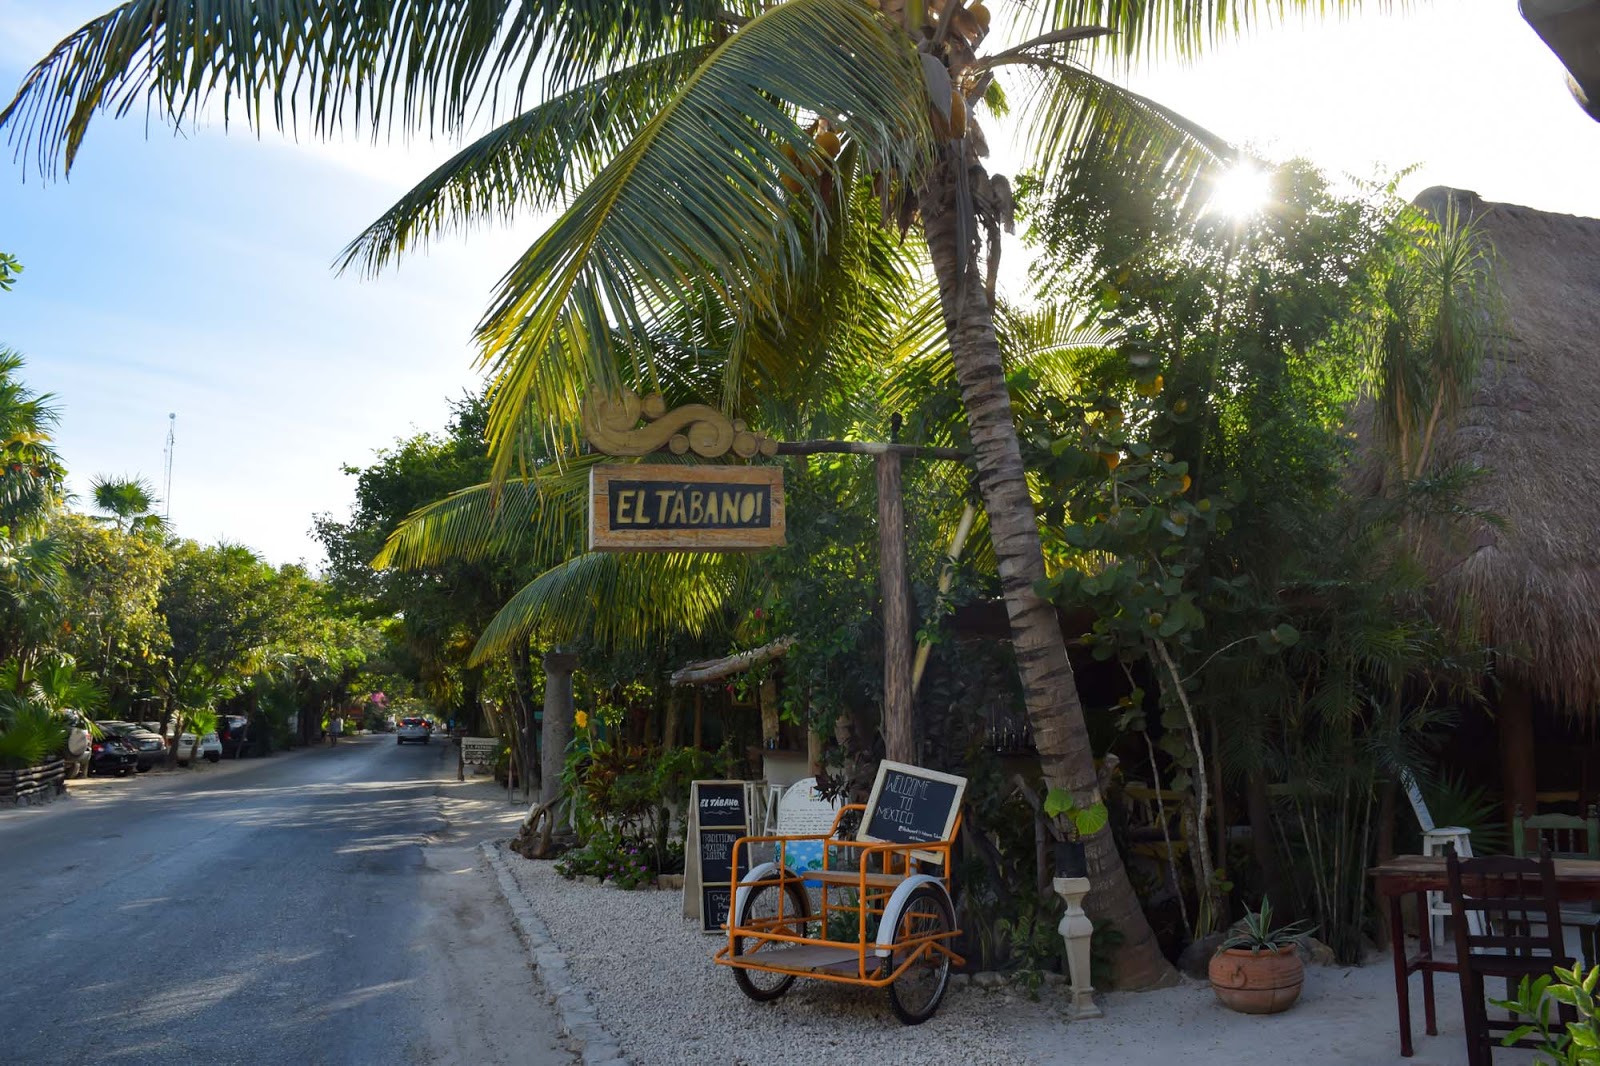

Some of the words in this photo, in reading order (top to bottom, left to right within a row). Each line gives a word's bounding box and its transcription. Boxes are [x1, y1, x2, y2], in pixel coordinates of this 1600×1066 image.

[616, 489, 651, 524] EL
[655, 484, 764, 525] TÁBANO!
[885, 773, 931, 801] WELCOME
[700, 798, 709, 807] EL
[899, 795, 914, 811] TO
